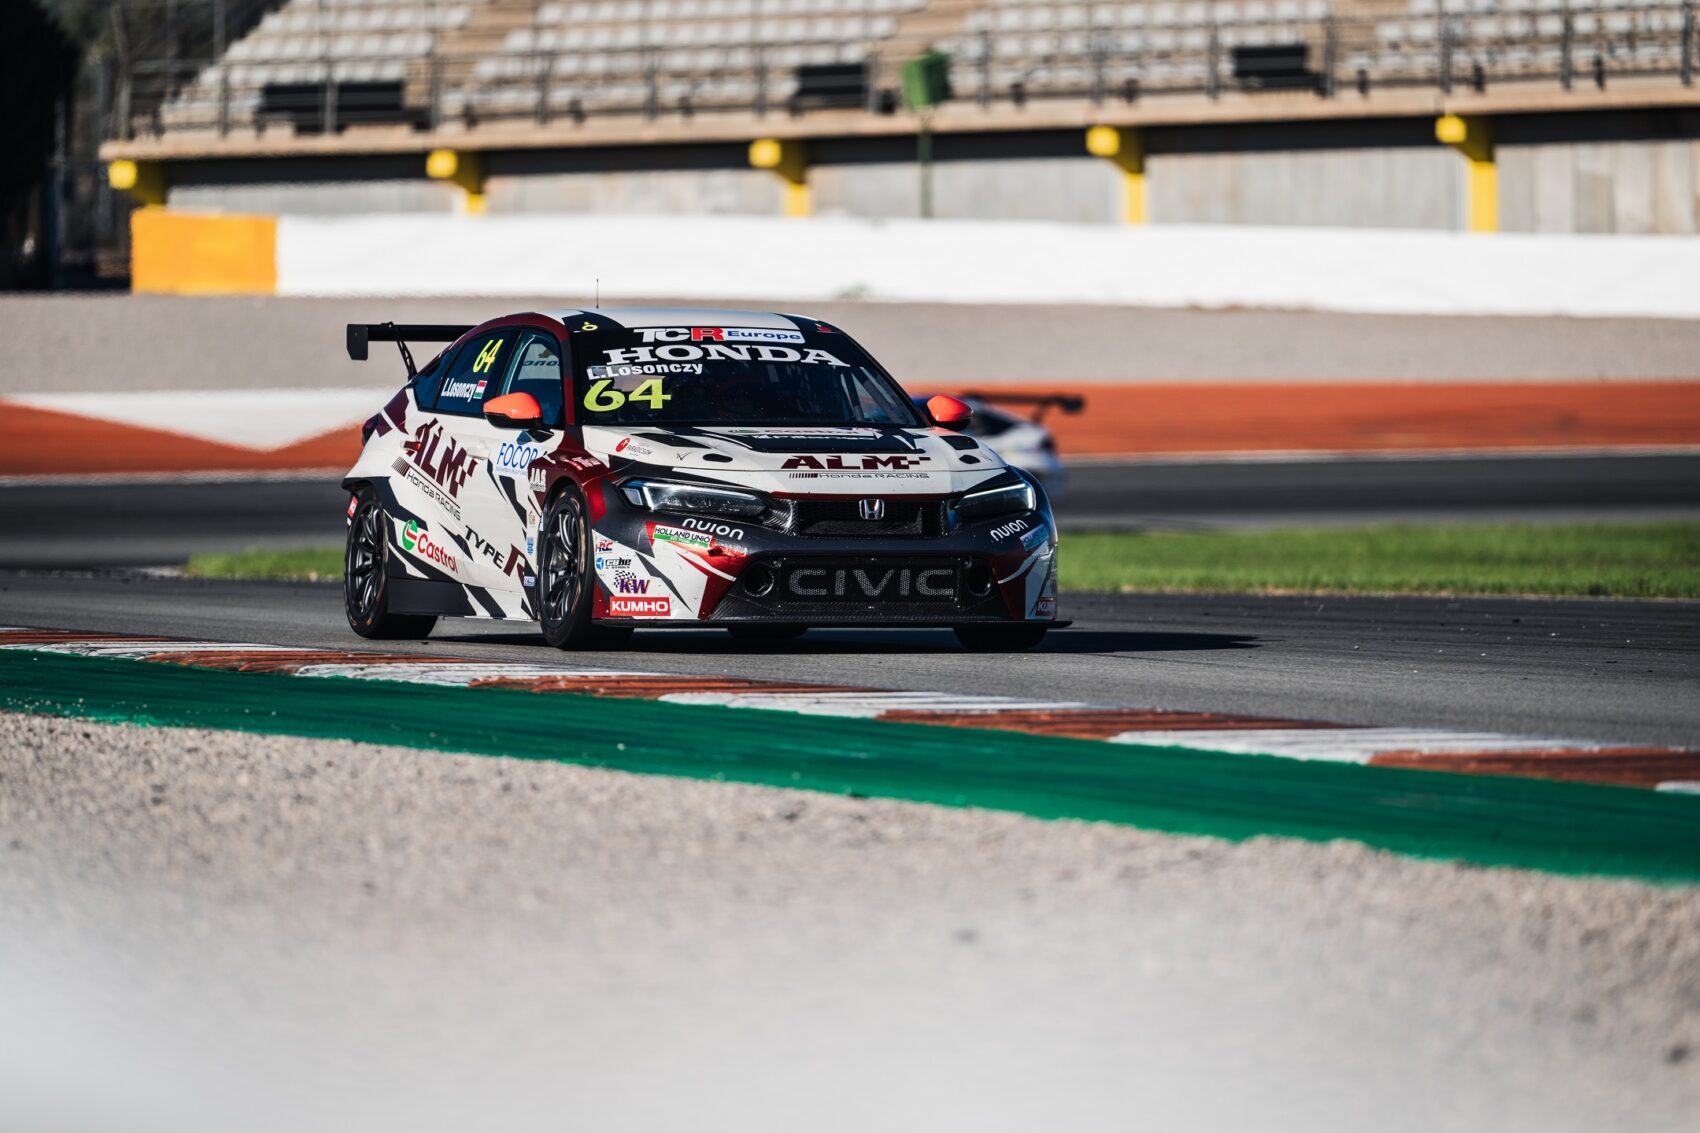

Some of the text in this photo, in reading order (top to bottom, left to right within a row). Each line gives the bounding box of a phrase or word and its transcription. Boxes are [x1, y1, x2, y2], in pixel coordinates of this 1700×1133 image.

[633, 327, 802, 343] TCR Europe
[473, 339, 504, 373] 64
[603, 344, 851, 368] HONDA
[587, 362, 704, 381] L.Losonczy
[441, 377, 477, 403] L.Losonczy
[583, 378, 672, 412] 64
[402, 417, 474, 500] ALM
[781, 455, 916, 470] ALM
[407, 470, 436, 499] Honda
[655, 527, 691, 539] HOLLAND
[417, 533, 459, 575] Castrol
[465, 525, 526, 585] TYPE R
[619, 578, 650, 595] KW
[788, 568, 955, 597] CIVIC
[611, 600, 669, 613] KUMHO
